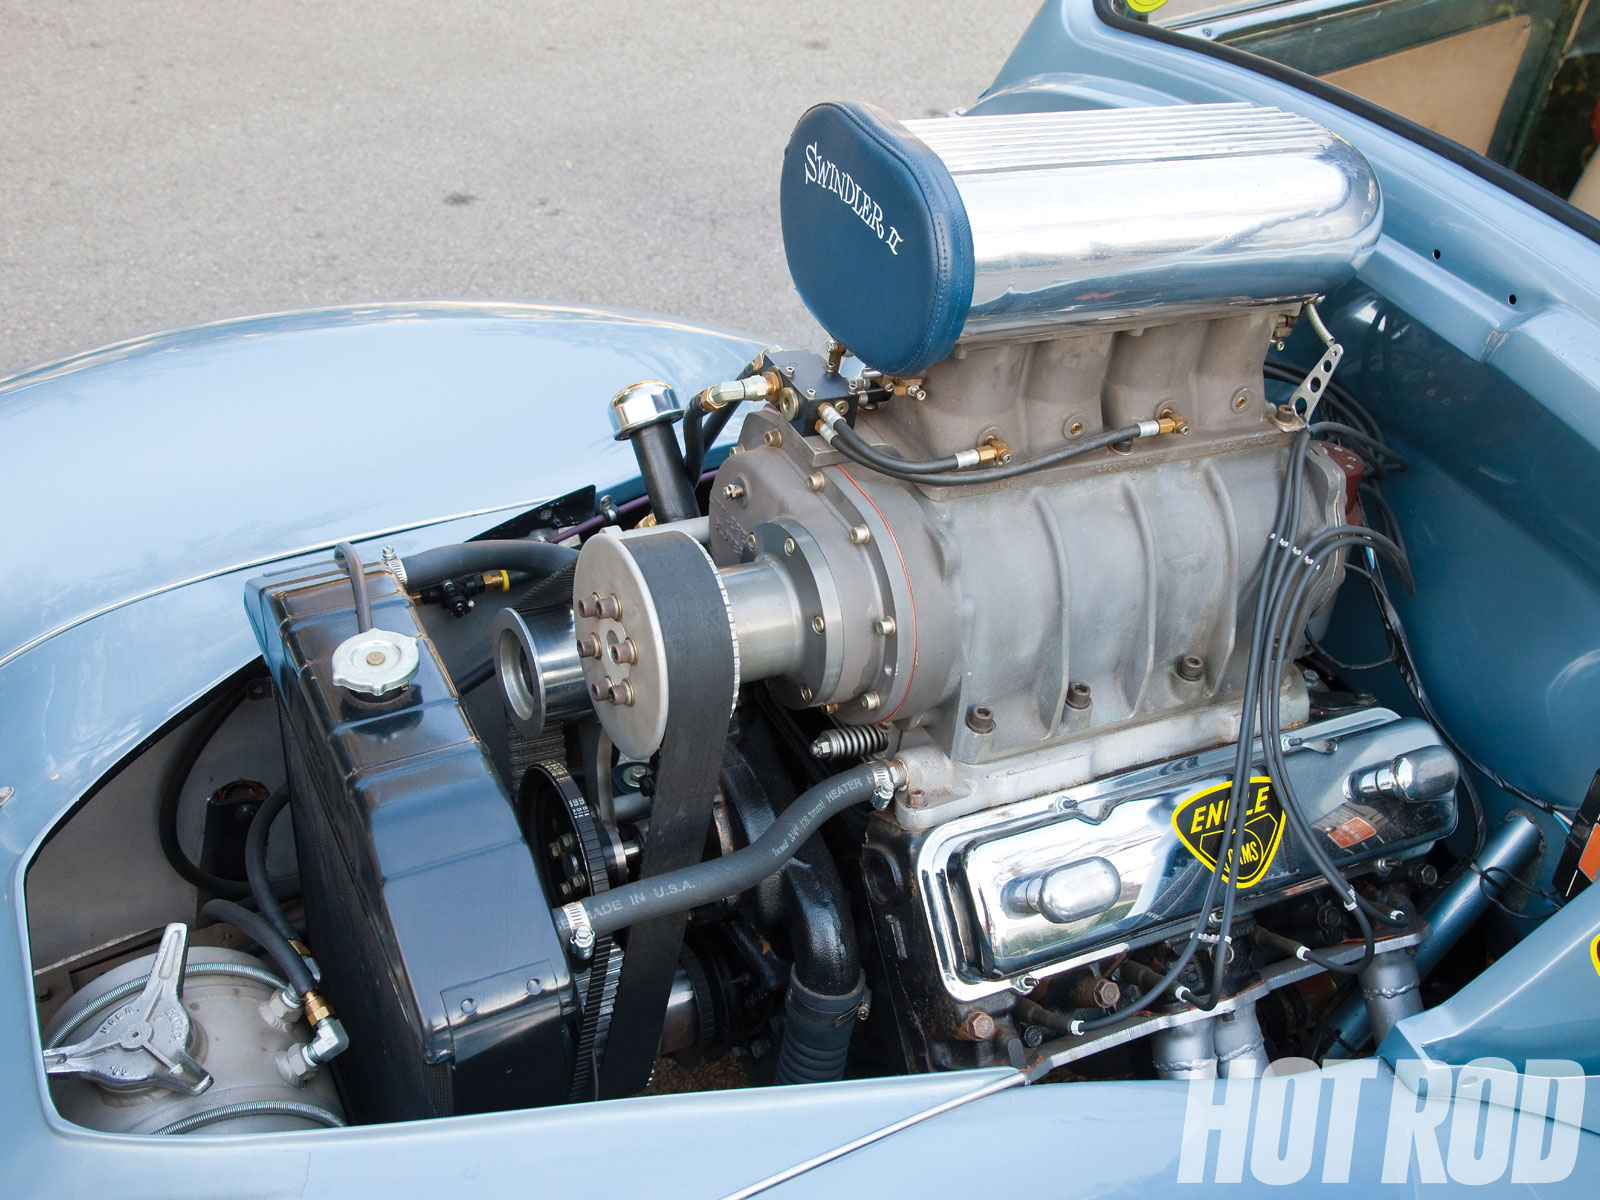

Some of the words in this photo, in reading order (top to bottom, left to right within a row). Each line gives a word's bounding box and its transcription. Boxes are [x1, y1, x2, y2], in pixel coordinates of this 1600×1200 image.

[825, 777, 863, 803] HEATER
[629, 892, 647, 906] IN
[653, 880, 697, 899] U.S.A.
